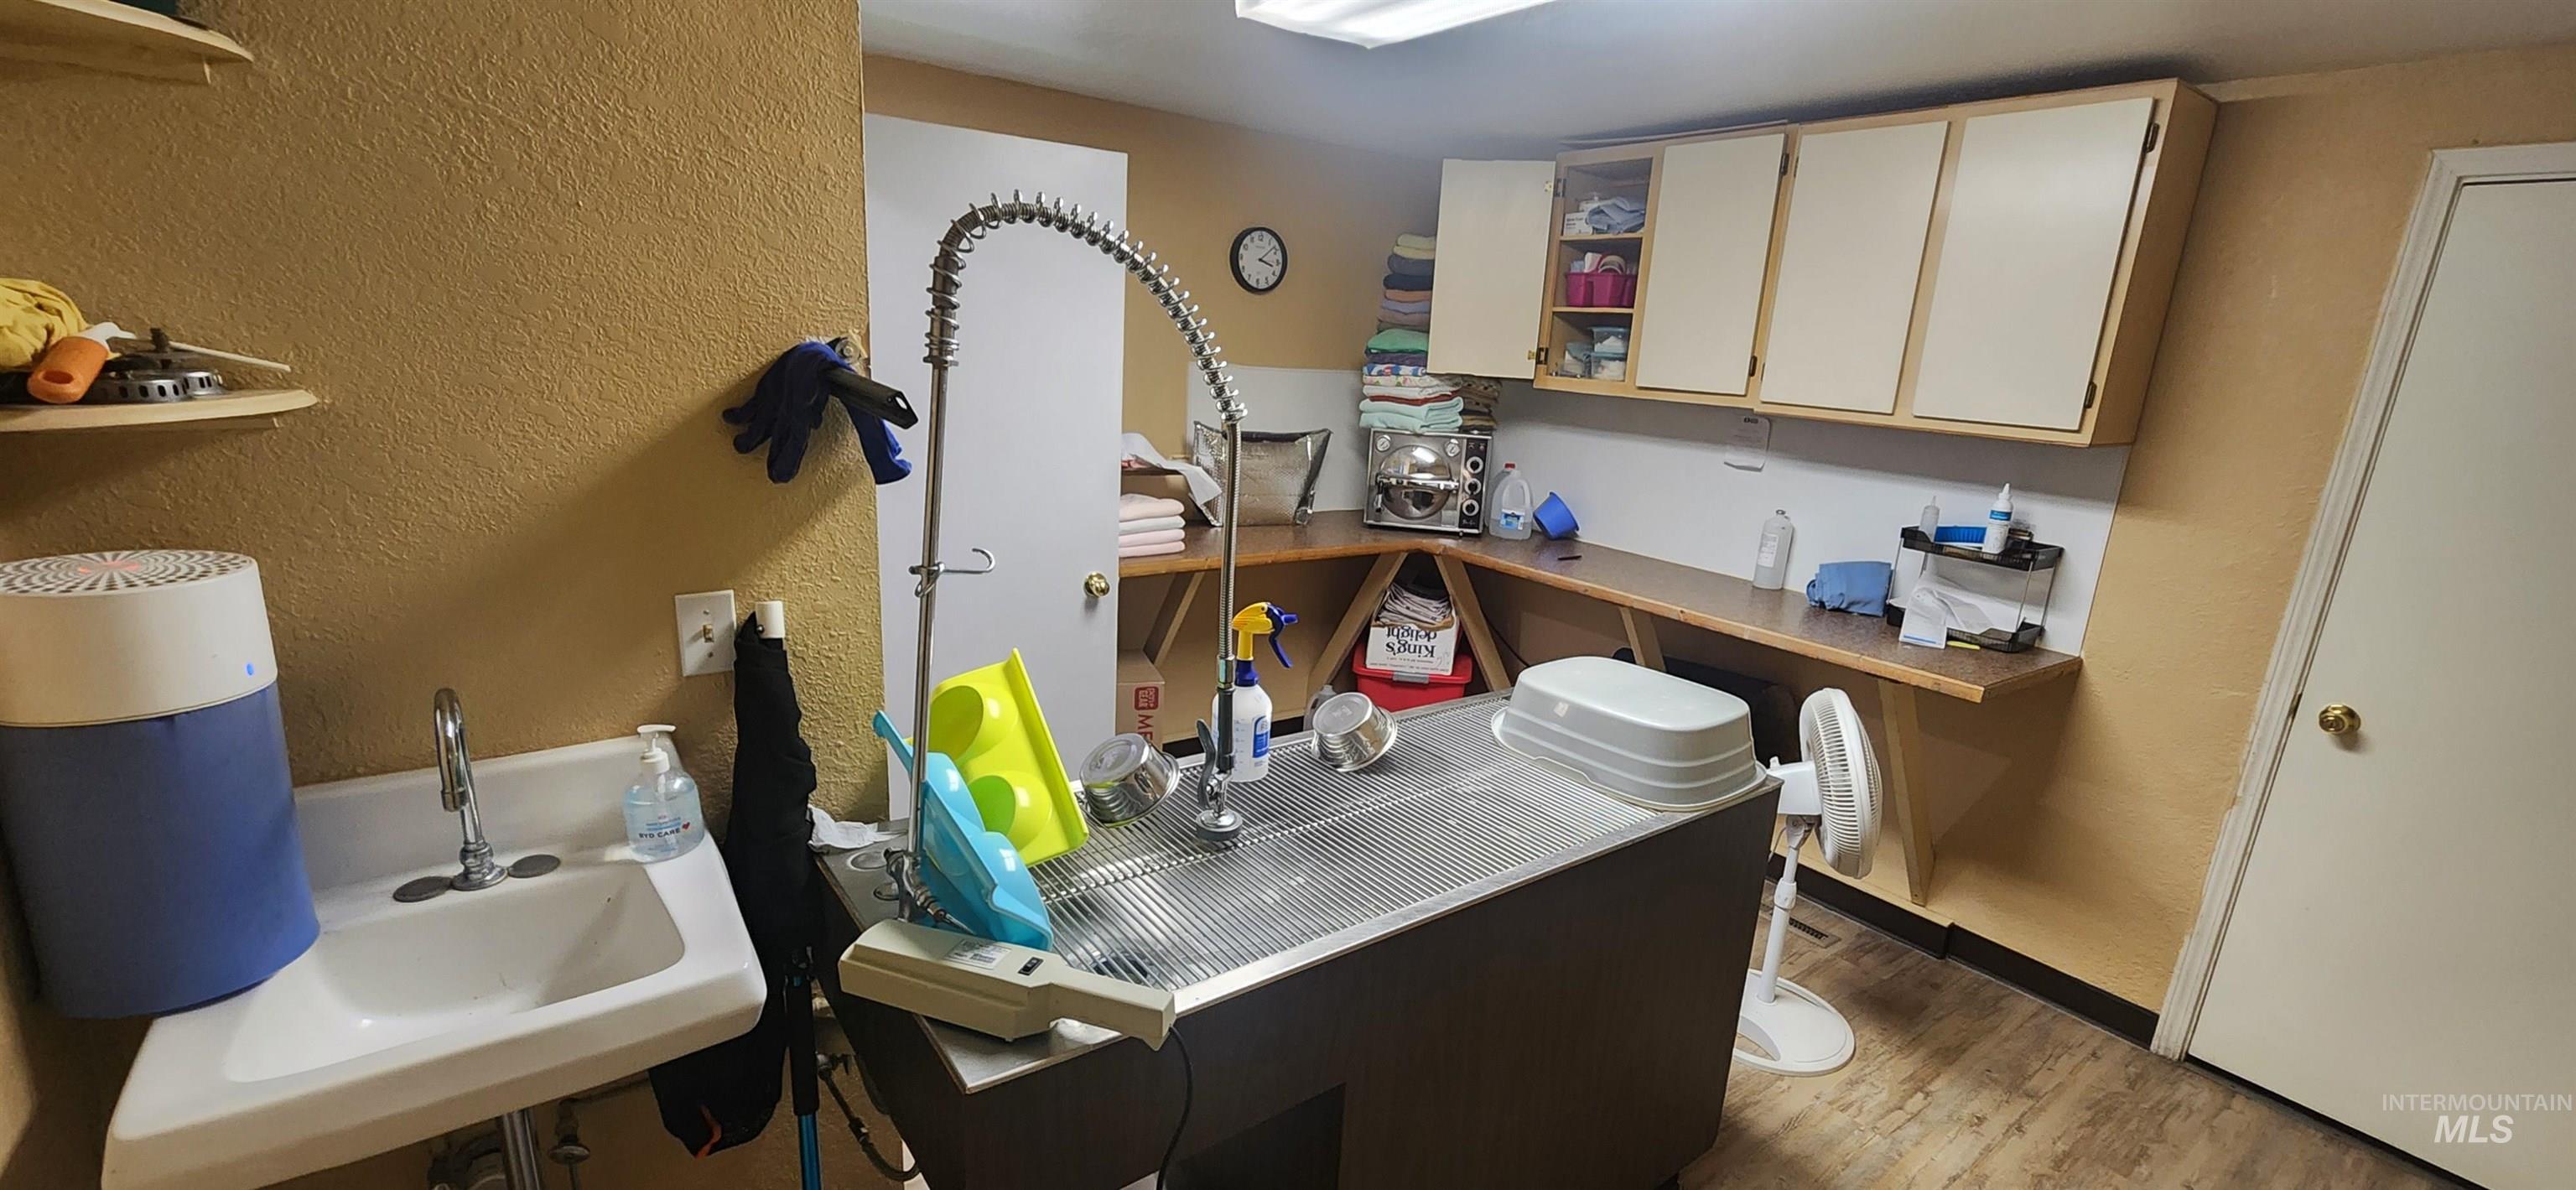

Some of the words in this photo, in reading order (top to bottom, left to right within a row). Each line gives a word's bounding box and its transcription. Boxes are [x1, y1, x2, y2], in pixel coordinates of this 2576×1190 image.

[1386, 626, 1437, 642] delight
[1385, 639, 1436, 657] King's
[657, 828, 680, 838] CARE
